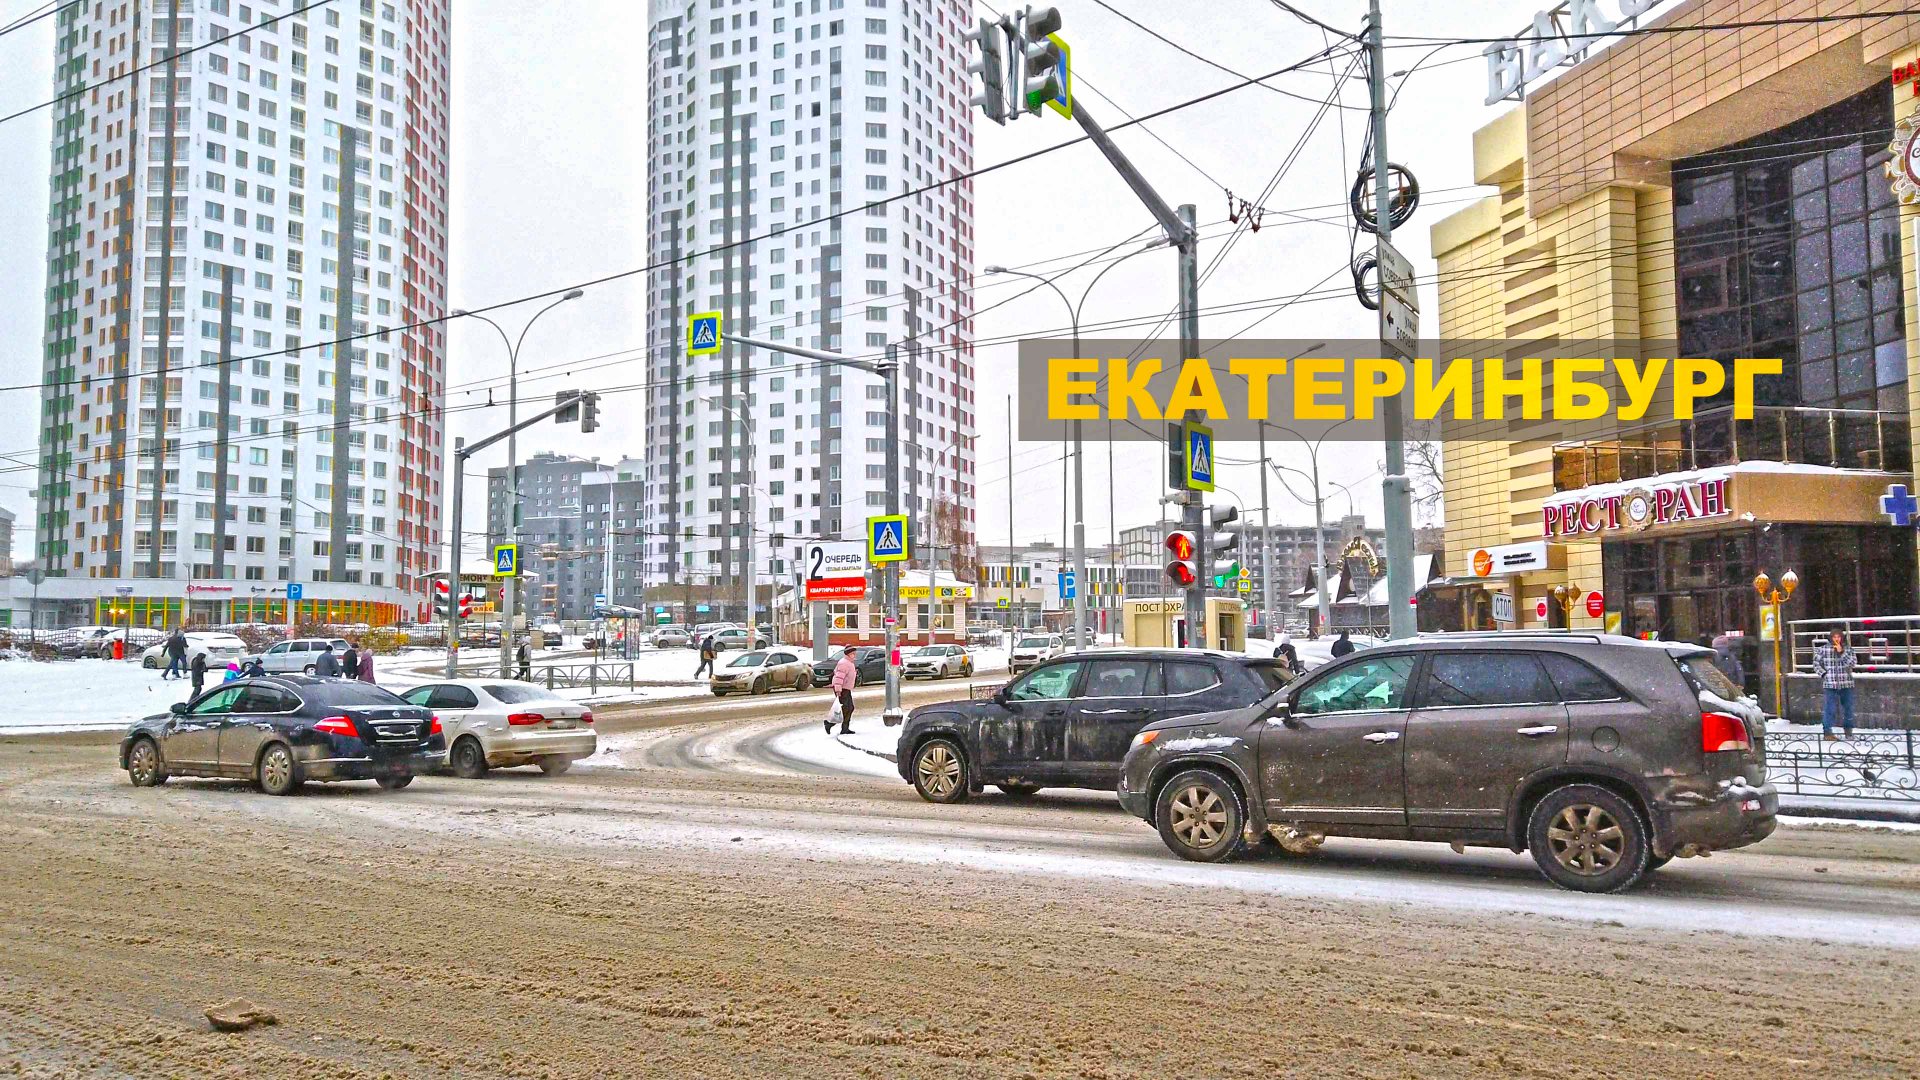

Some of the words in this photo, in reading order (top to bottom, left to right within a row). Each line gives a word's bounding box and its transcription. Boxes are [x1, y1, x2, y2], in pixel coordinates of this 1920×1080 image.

[810, 546, 824, 582] 2
[824, 554, 862, 564] ОЧЕРЕДЬ
[907, 588, 930, 596] КУХН
[1135, 602, 1161, 613] ПОСТ
[1495, 597, 1512, 617] СТОП
